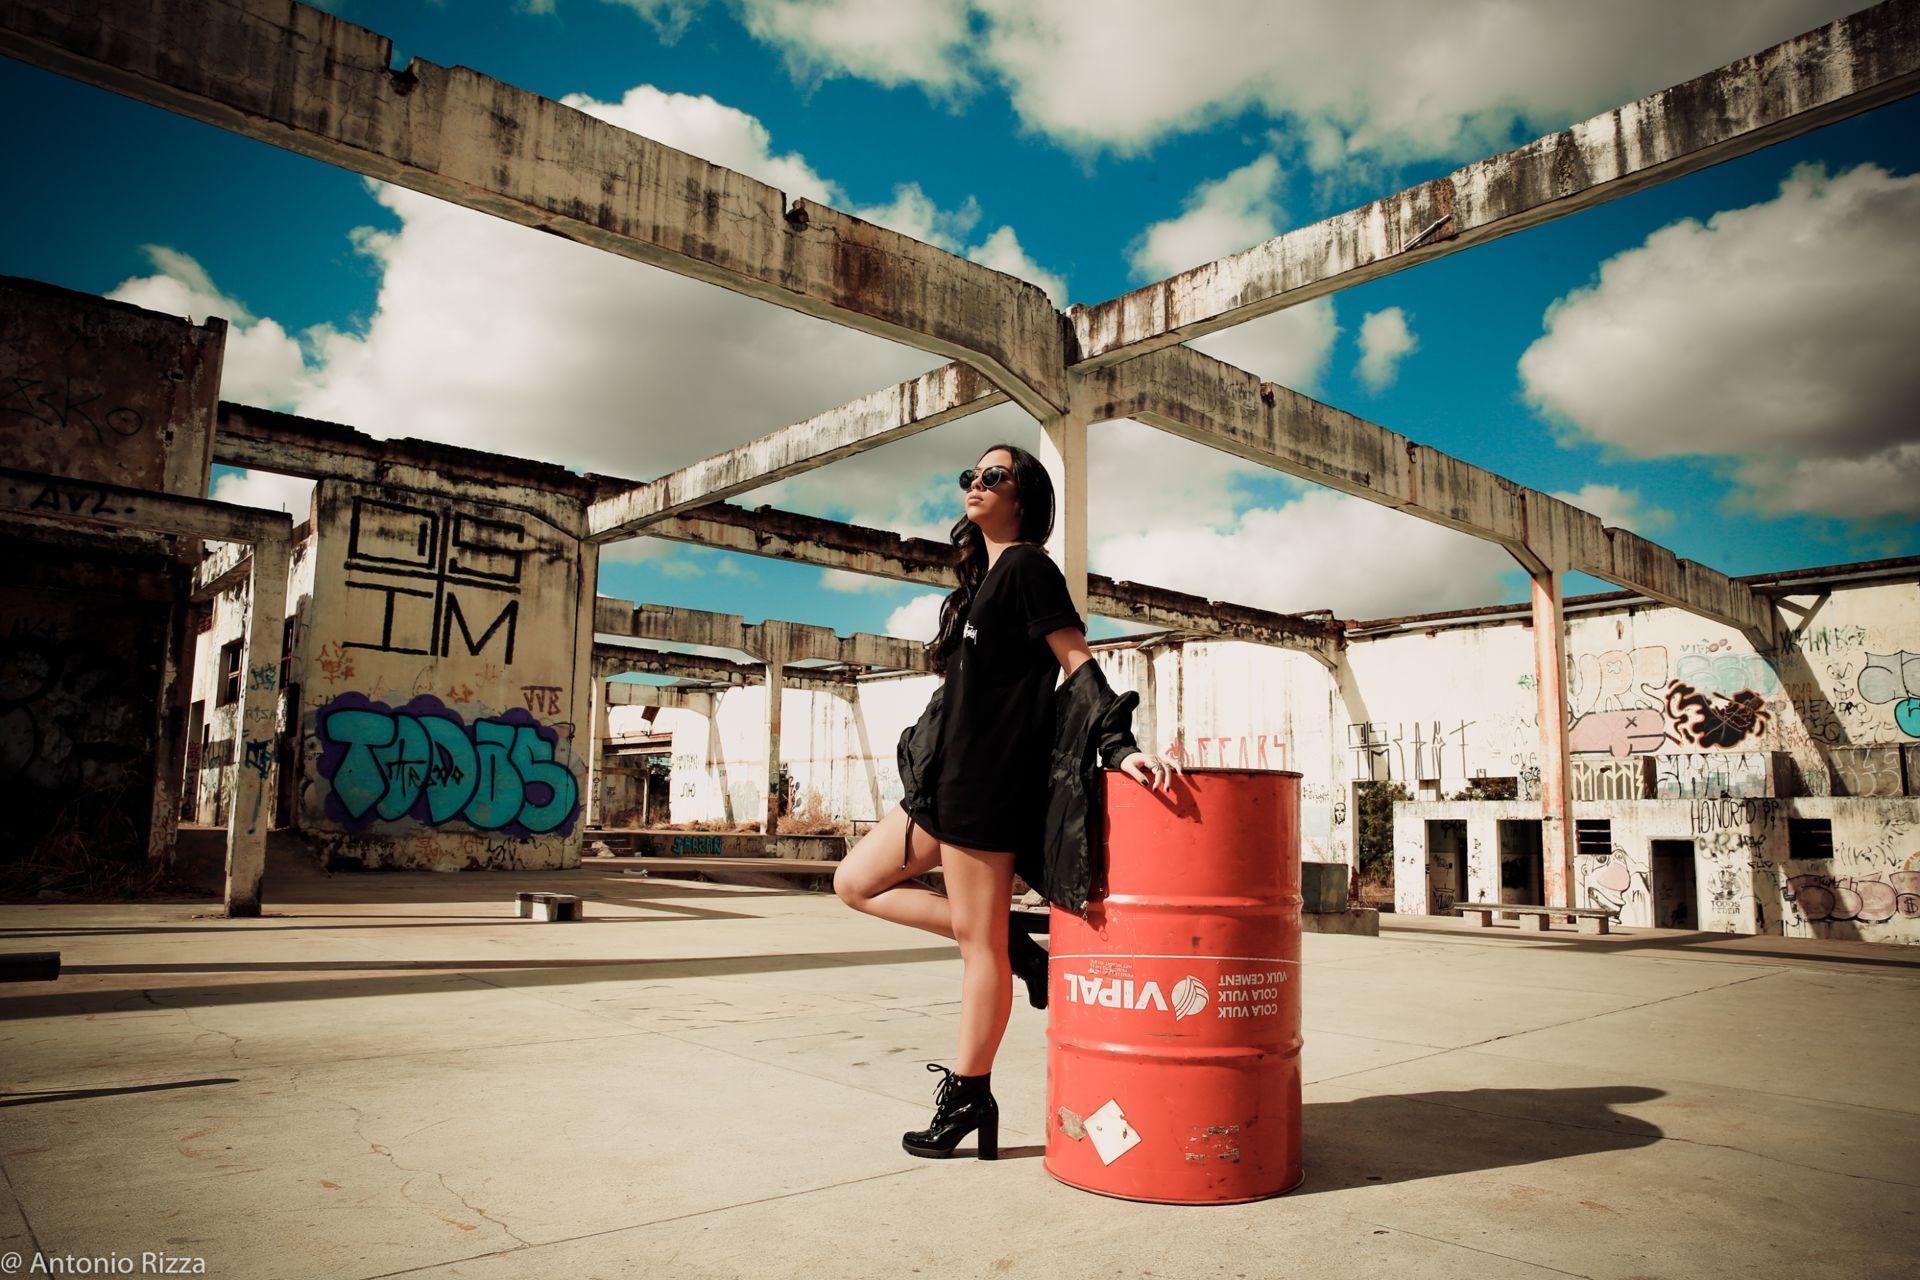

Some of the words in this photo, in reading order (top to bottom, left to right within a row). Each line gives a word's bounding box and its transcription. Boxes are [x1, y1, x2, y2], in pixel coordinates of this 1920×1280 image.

[1218, 973, 1264, 987] CEMENT
[1267, 970, 1288, 984] VULK
[1064, 973, 1168, 1012] VIPAL
[1218, 990, 1249, 1002] VULK
[1252, 987, 1278, 1001] COLA
[1218, 1006, 1249, 1019] VULK
[1252, 1003, 1278, 1017] COLA
